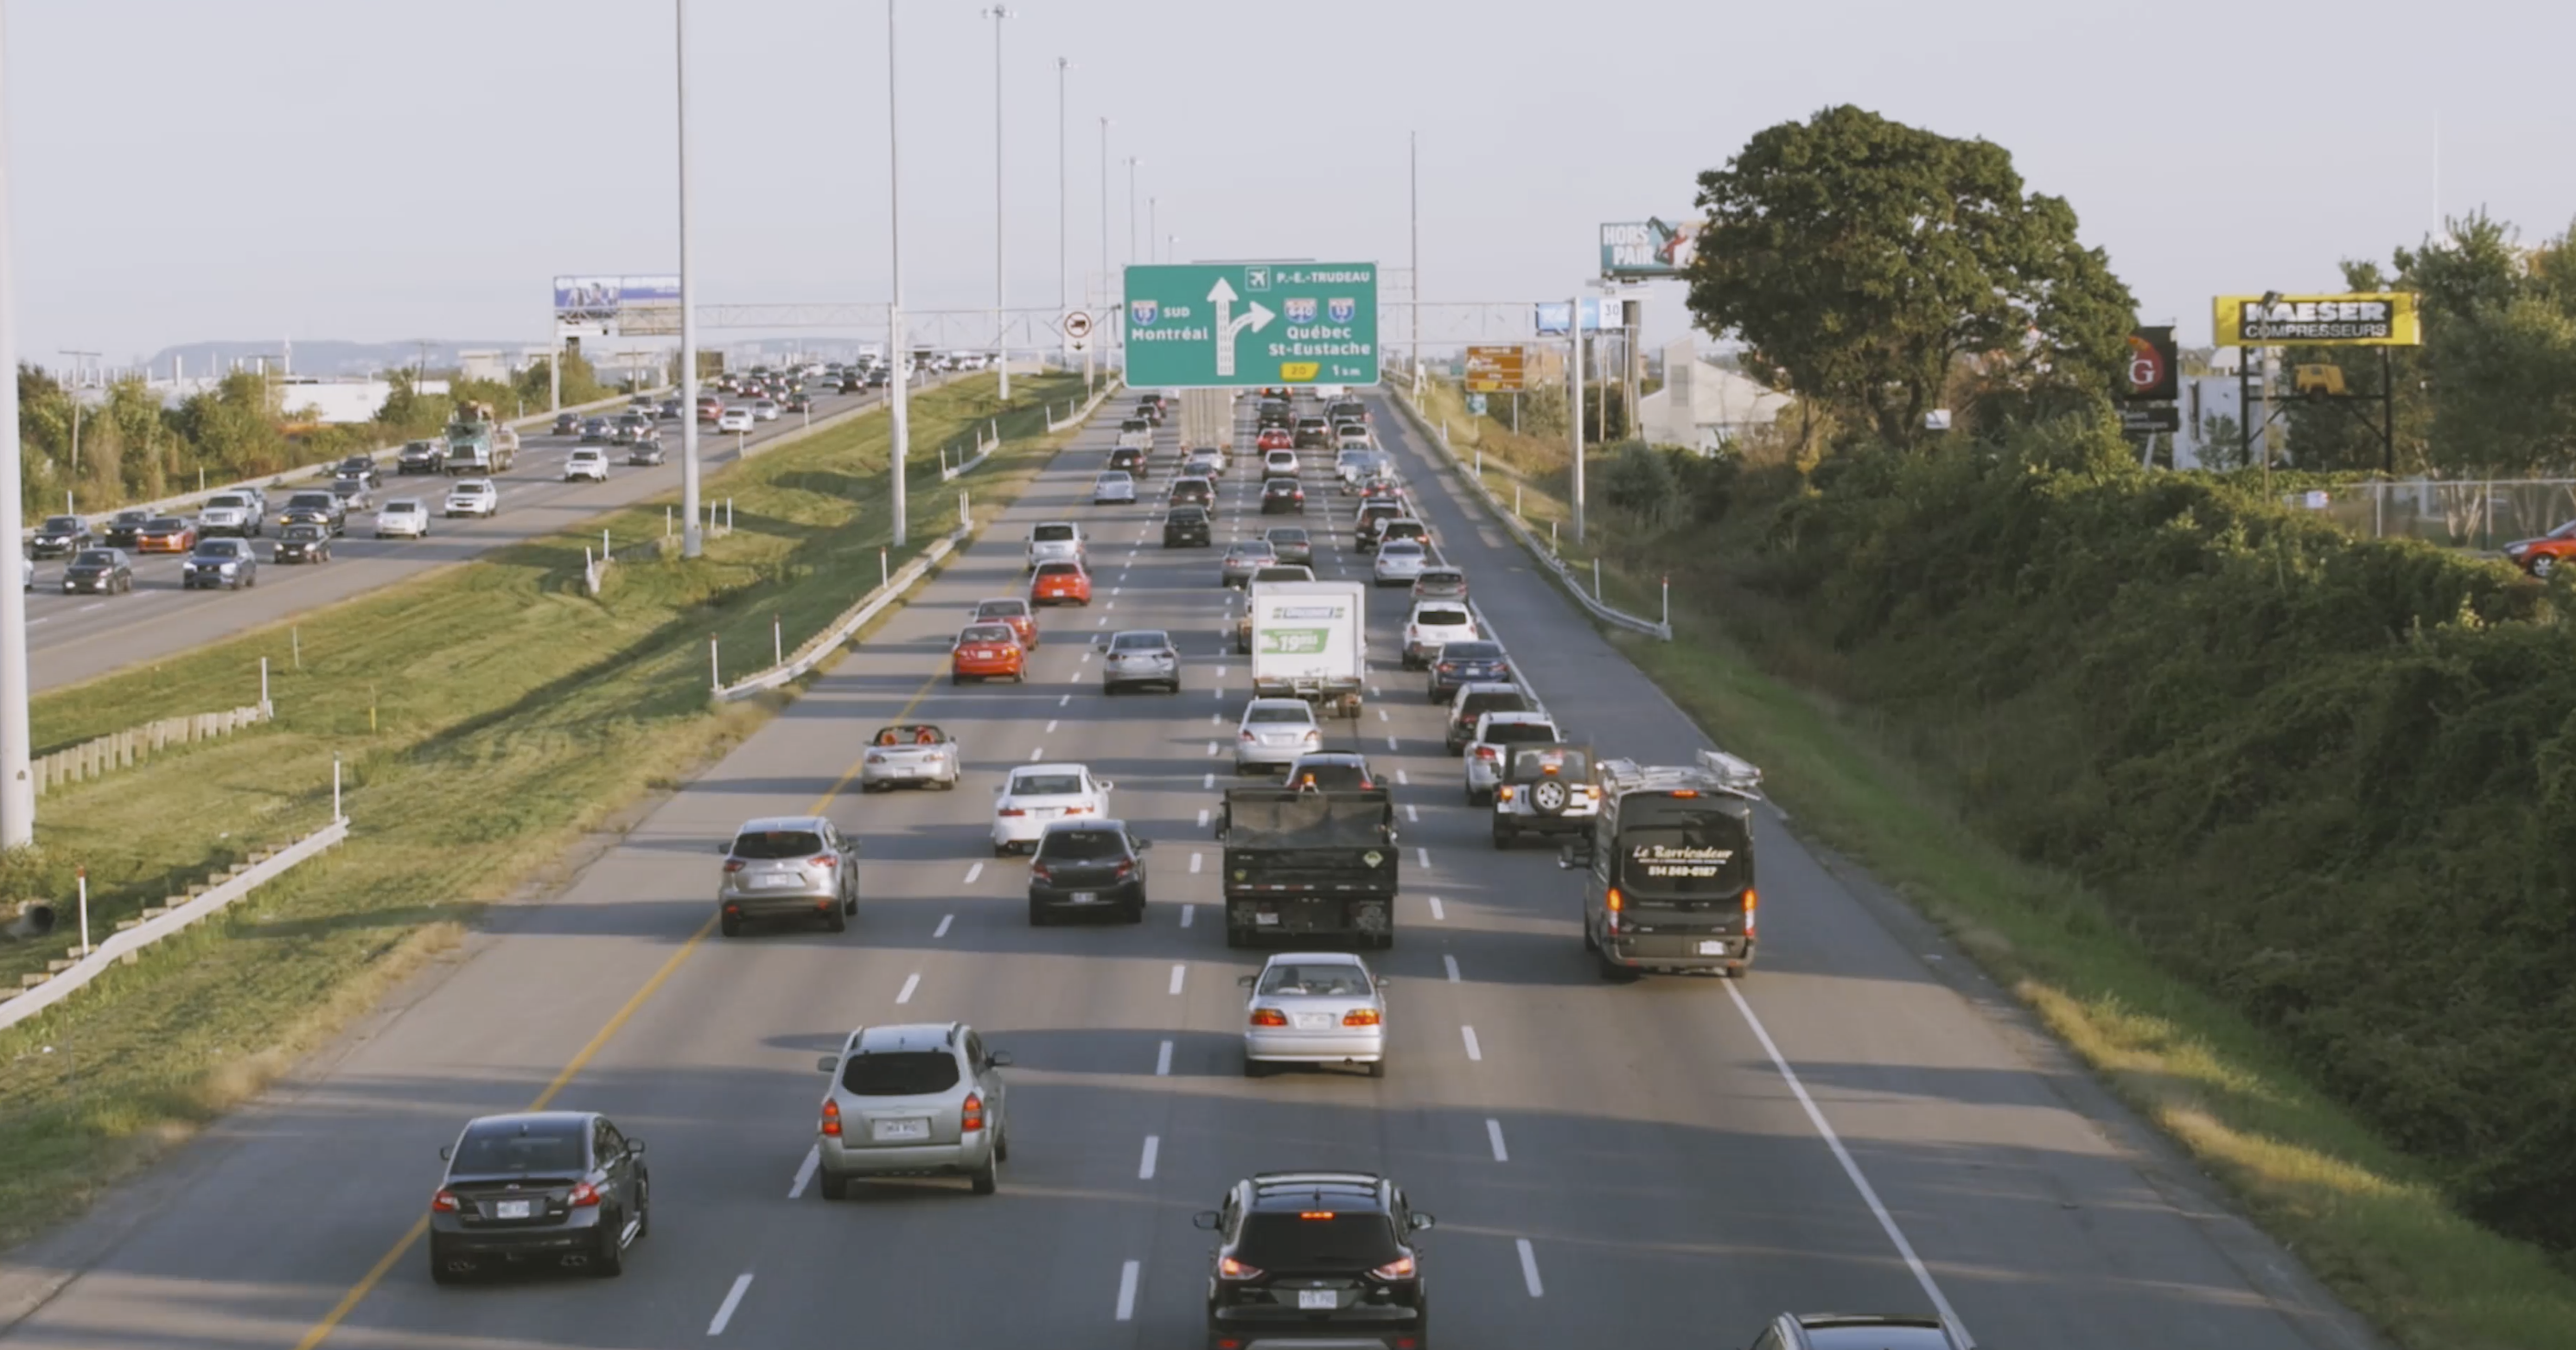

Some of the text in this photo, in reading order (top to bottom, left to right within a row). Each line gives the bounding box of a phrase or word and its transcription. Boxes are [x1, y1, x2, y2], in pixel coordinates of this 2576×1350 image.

[1603, 226, 1648, 245] HORS
[1276, 271, 1370, 283] P.-E.-TRUDEAU
[1163, 306, 1190, 318] SUD
[2245, 302, 2387, 322] KAESER
[1132, 327, 1208, 341] Montréal
[1286, 326, 1352, 340] Québec
[2245, 323, 2388, 338] COMPRESSEURS
[1268, 342, 1371, 356] St-Eustache
[1291, 366, 1307, 375] 20
[1332, 364, 1339, 376] 1
[1633, 845, 1649, 857] Le
